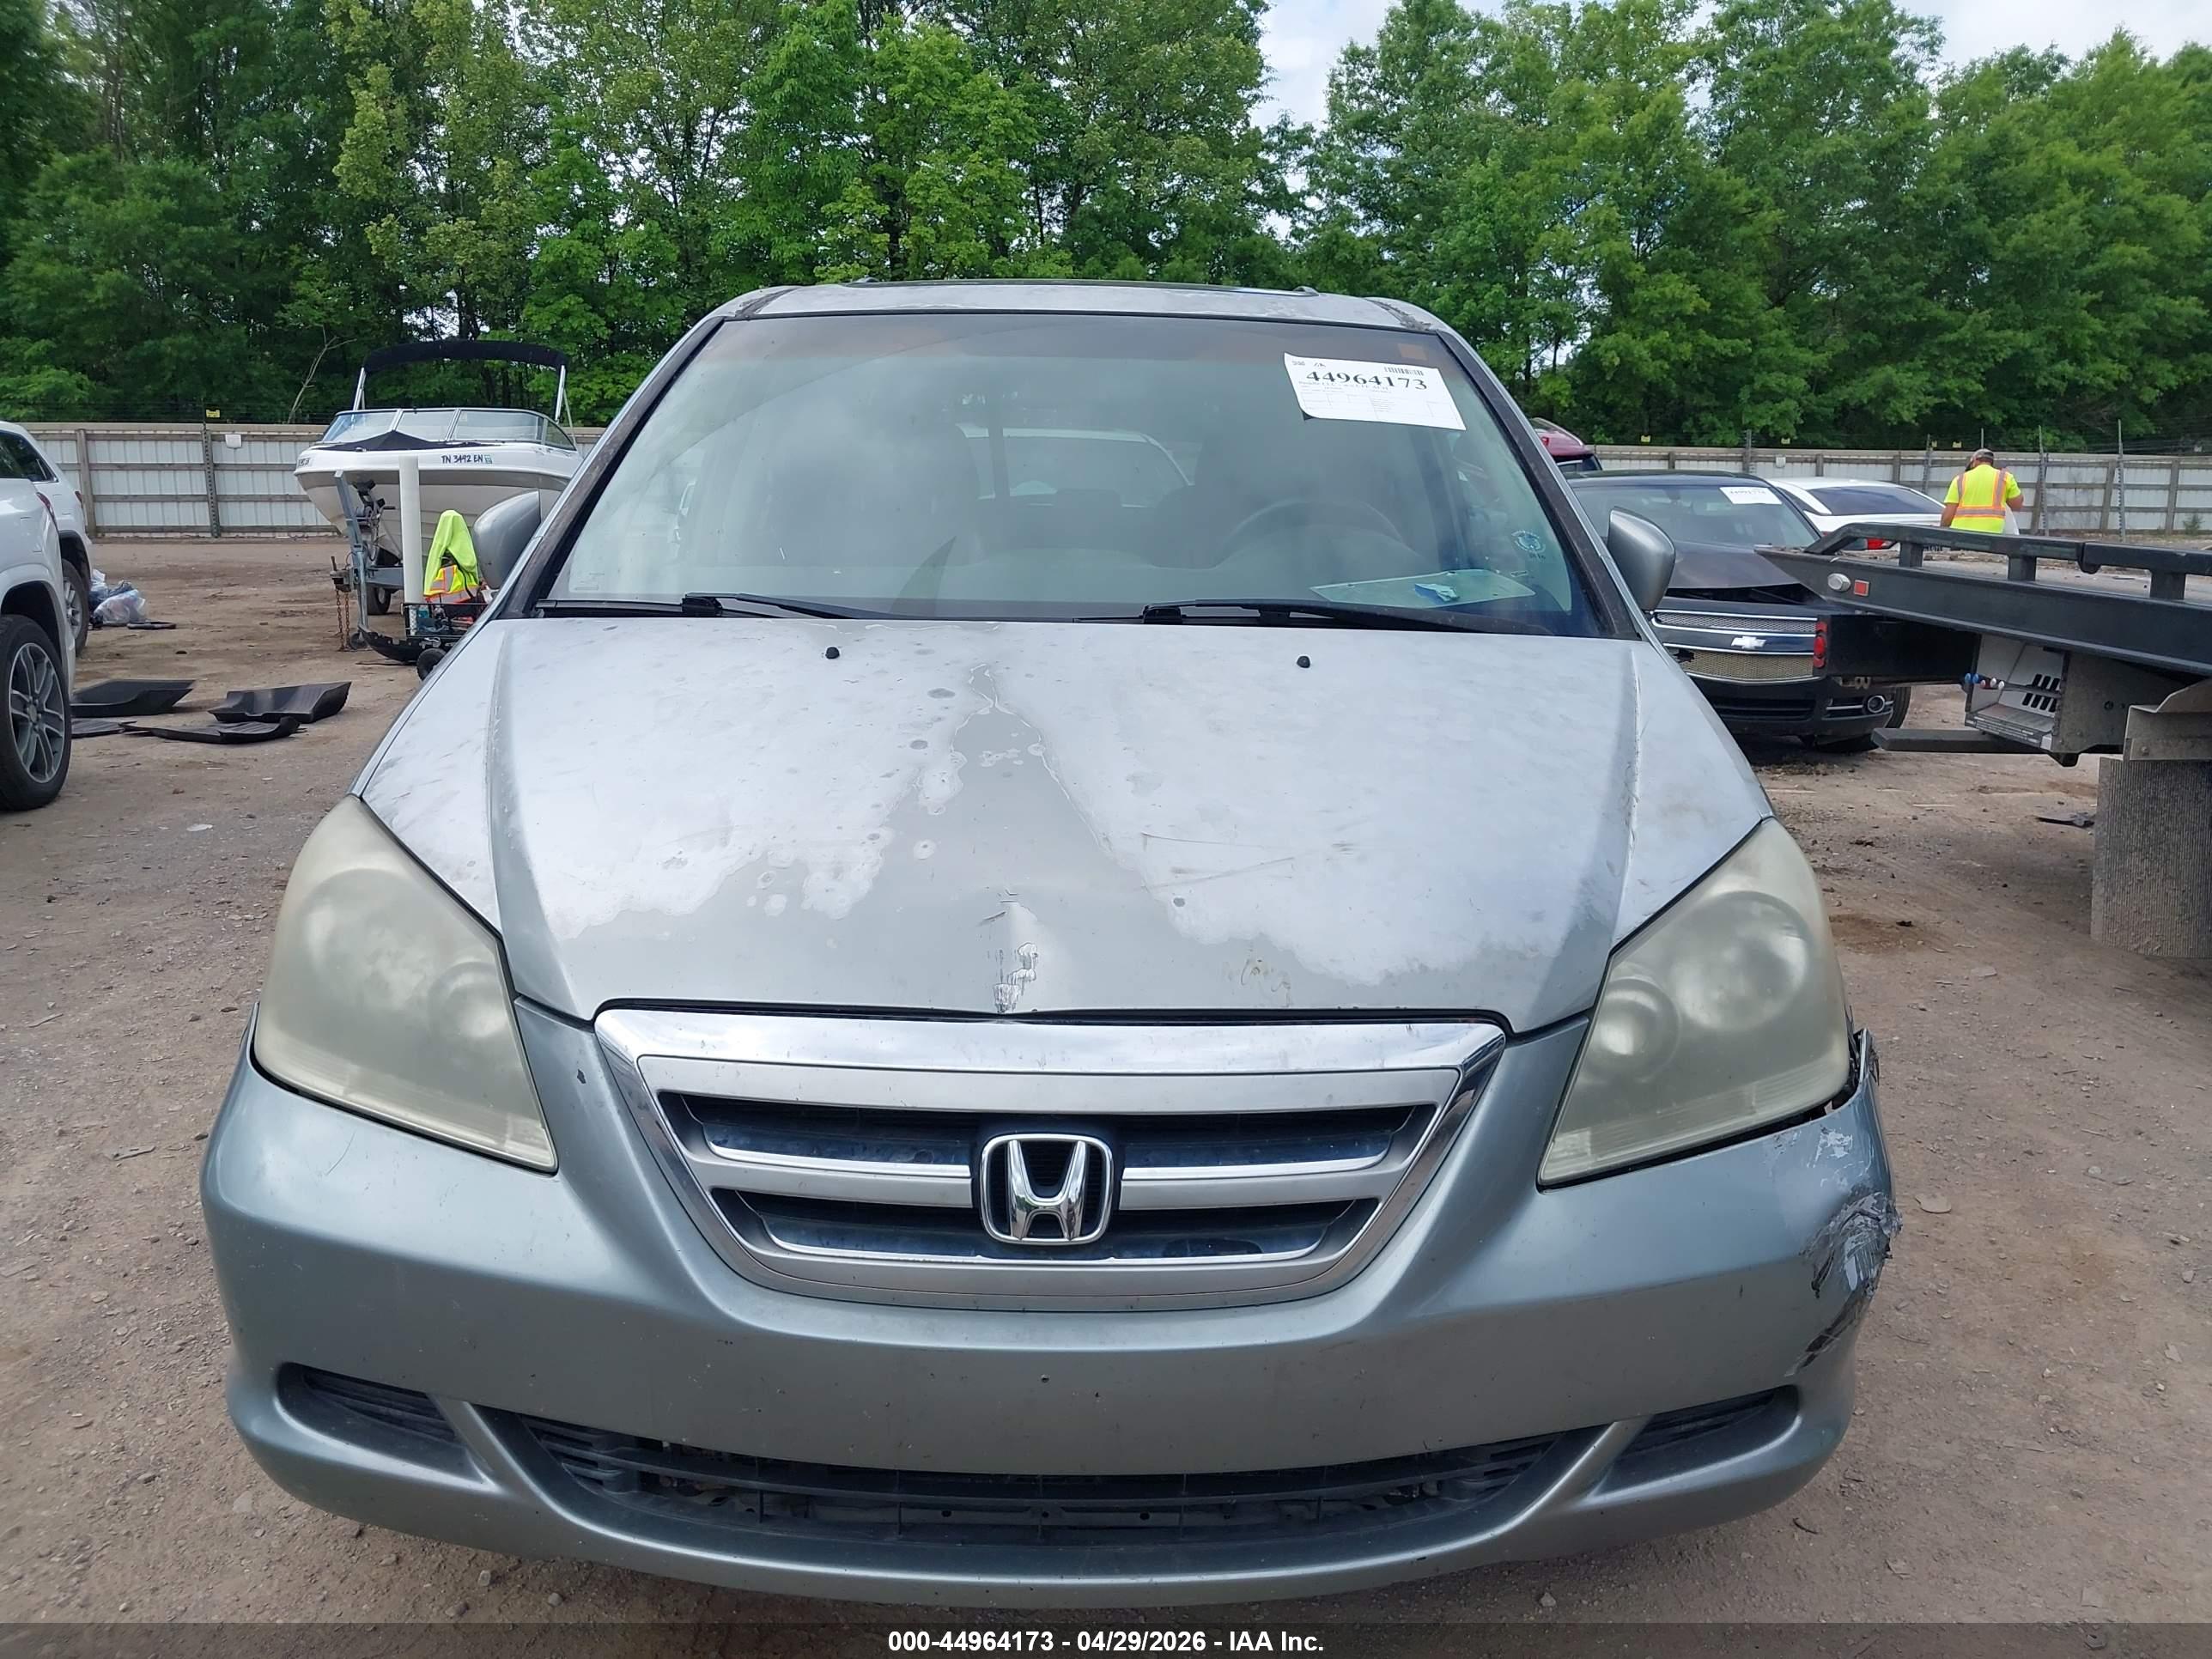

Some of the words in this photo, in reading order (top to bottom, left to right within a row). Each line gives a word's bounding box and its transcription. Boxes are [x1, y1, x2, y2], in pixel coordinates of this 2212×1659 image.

[1306, 371, 1427, 390] 44964173
[441, 454, 452, 464] TN
[453, 454, 471, 464] 3492
[473, 454, 483, 463] EN
